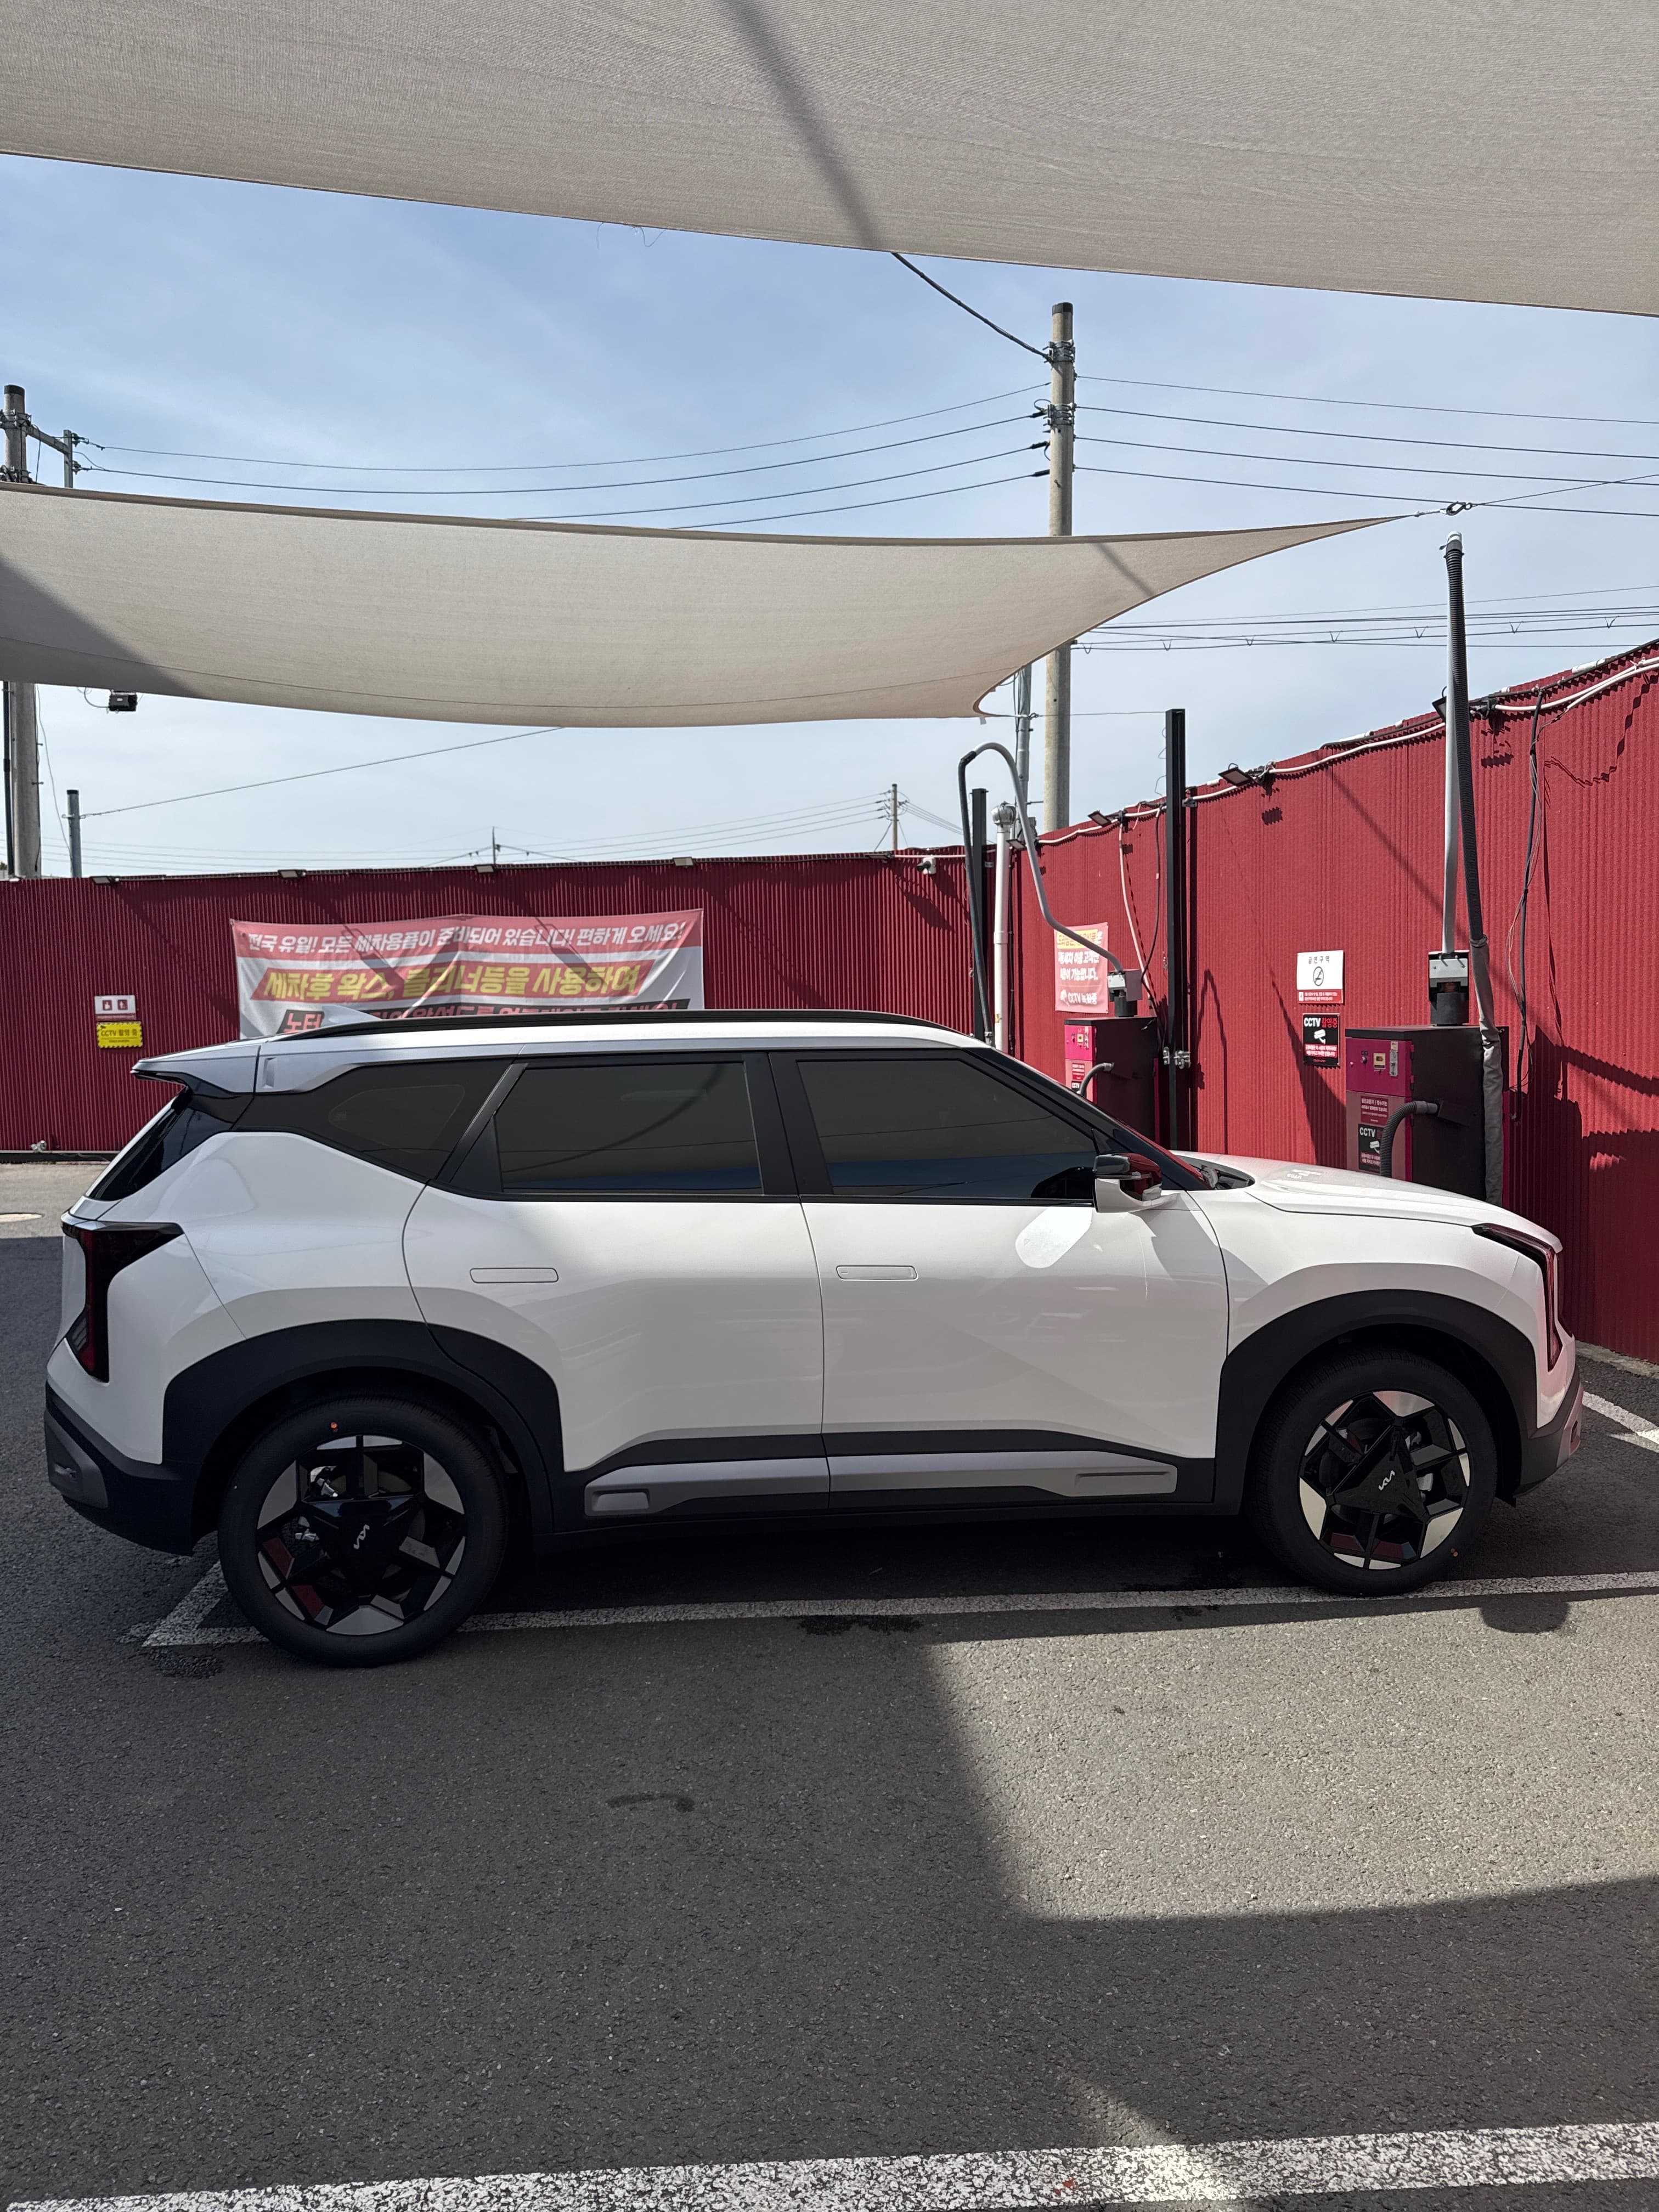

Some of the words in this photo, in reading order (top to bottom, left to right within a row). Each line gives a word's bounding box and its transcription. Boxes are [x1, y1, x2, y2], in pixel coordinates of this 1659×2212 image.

[248, 933, 278, 952] 전국
[278, 935, 318, 954] 유일!
[318, 935, 353, 953] 모든
[355, 929, 436, 952] 세차용품이
[437, 926, 502, 946] 준비되어
[502, 928, 575, 947] 있습니다!
[577, 927, 628, 946] 편하게
[627, 922, 686, 944] 오세요!
[263, 972, 334, 1000] 세차후
[337, 972, 394, 1000] 왁스,
[403, 965, 531, 998] 클리너등을
[532, 964, 641, 996] 사용하여
[1304, 1017, 1321, 1027] CCTV
[1359, 1127, 1376, 1138] CCTV
